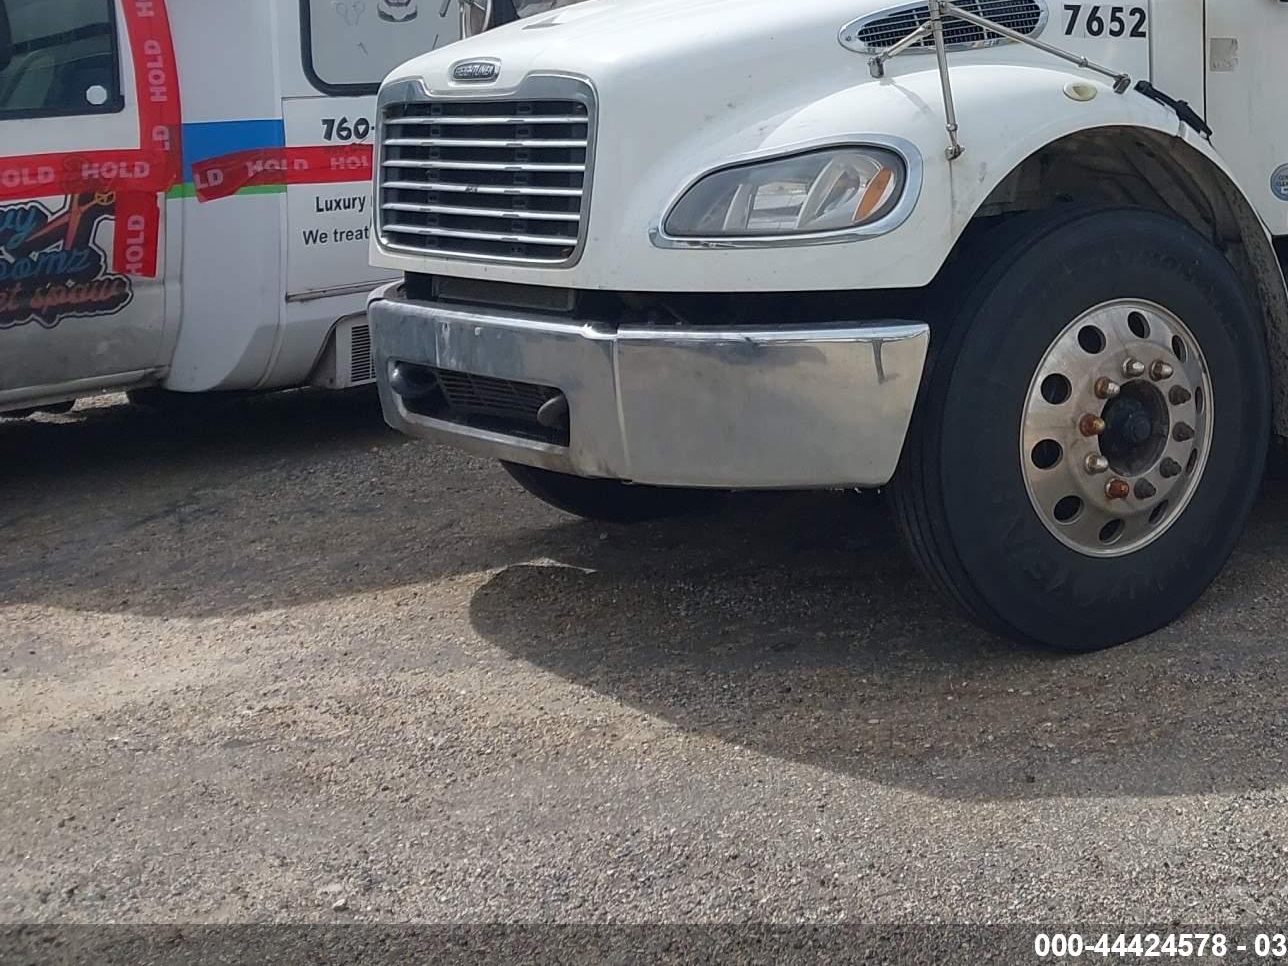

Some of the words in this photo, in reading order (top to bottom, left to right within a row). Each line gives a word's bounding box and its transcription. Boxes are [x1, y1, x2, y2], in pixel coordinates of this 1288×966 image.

[1063, 4, 1147, 38] 7652
[144, 39, 168, 102] HOLD
[2, 166, 55, 186] OLD
[81, 161, 150, 180] HOLD
[315, 195, 366, 212] Luxury
[124, 214, 146, 276] HOLD
[302, 229, 328, 245] We
[332, 225, 369, 242] treat
